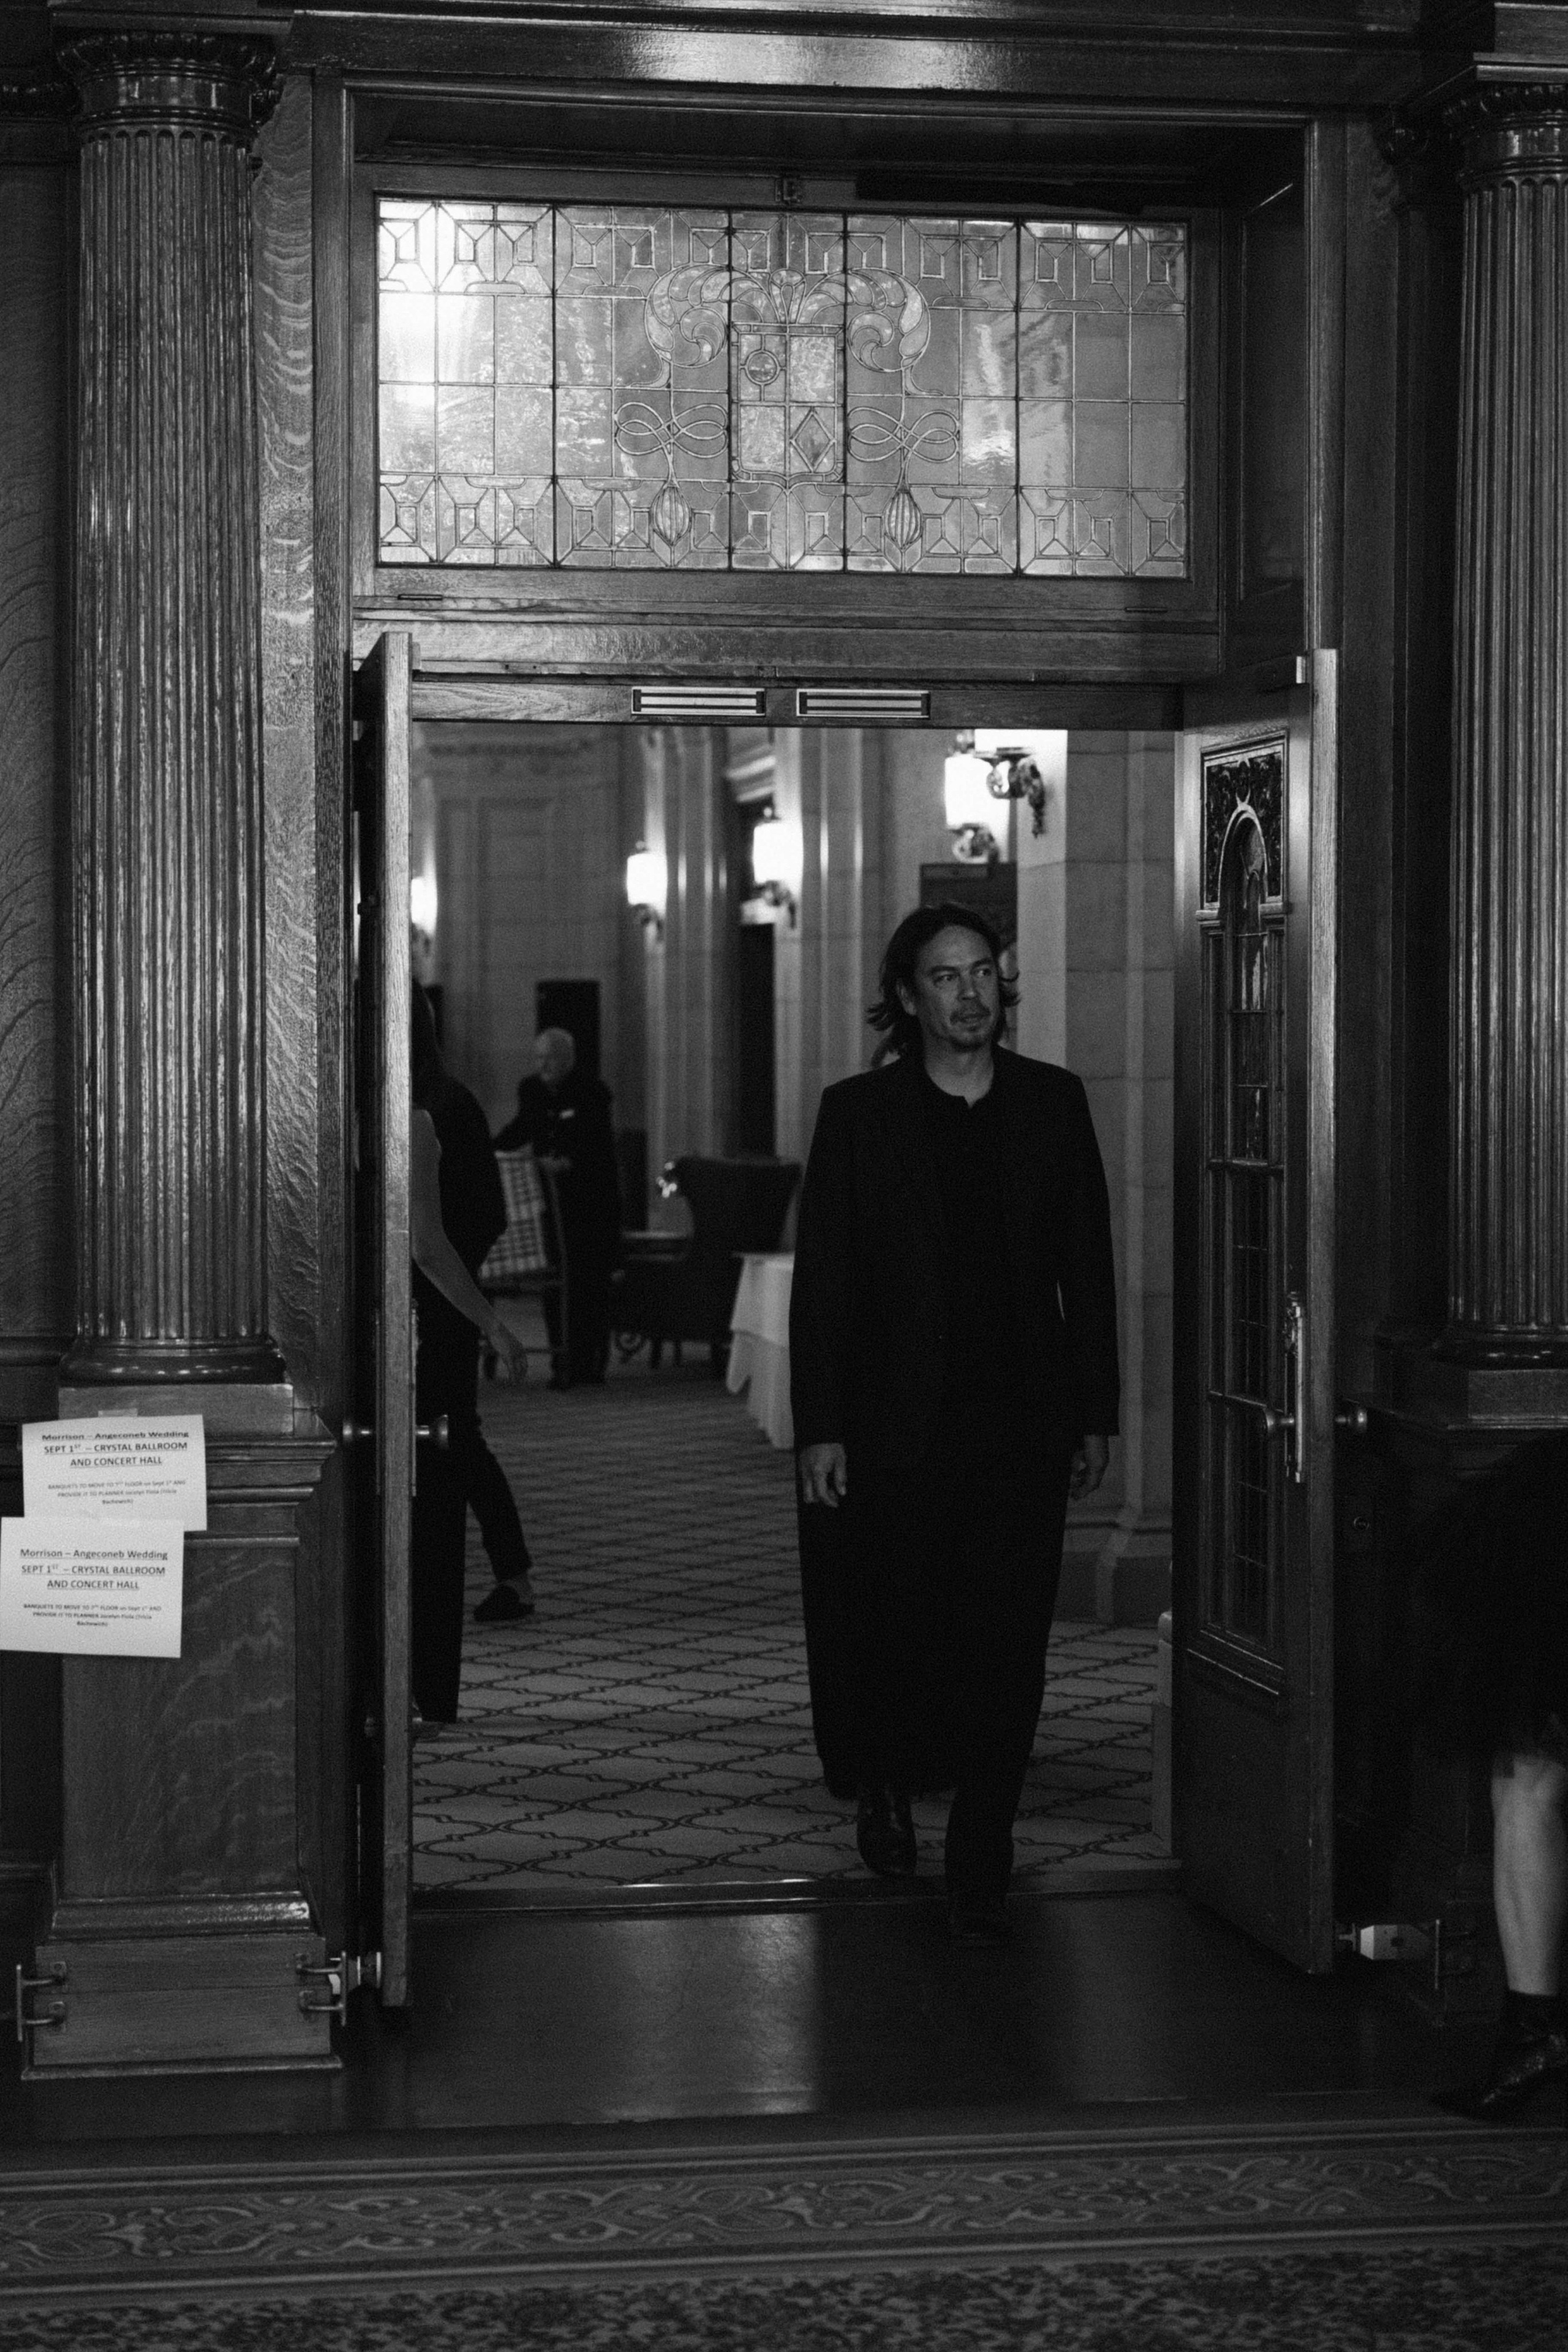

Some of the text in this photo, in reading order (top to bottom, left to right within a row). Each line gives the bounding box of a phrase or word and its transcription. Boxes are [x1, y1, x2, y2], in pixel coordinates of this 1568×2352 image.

[135, 1442, 187, 1450] BALLROOM
[94, 1457, 136, 1466] CONCERT
[140, 1456, 162, 1464] HALL
[74, 1550, 124, 1559] Angeconeb
[127, 1550, 167, 1560] Wedding
[21, 1565, 43, 1574] SEPT
[72, 1566, 109, 1574] CRYSTAL
[113, 1566, 165, 1575] BALLROOM
